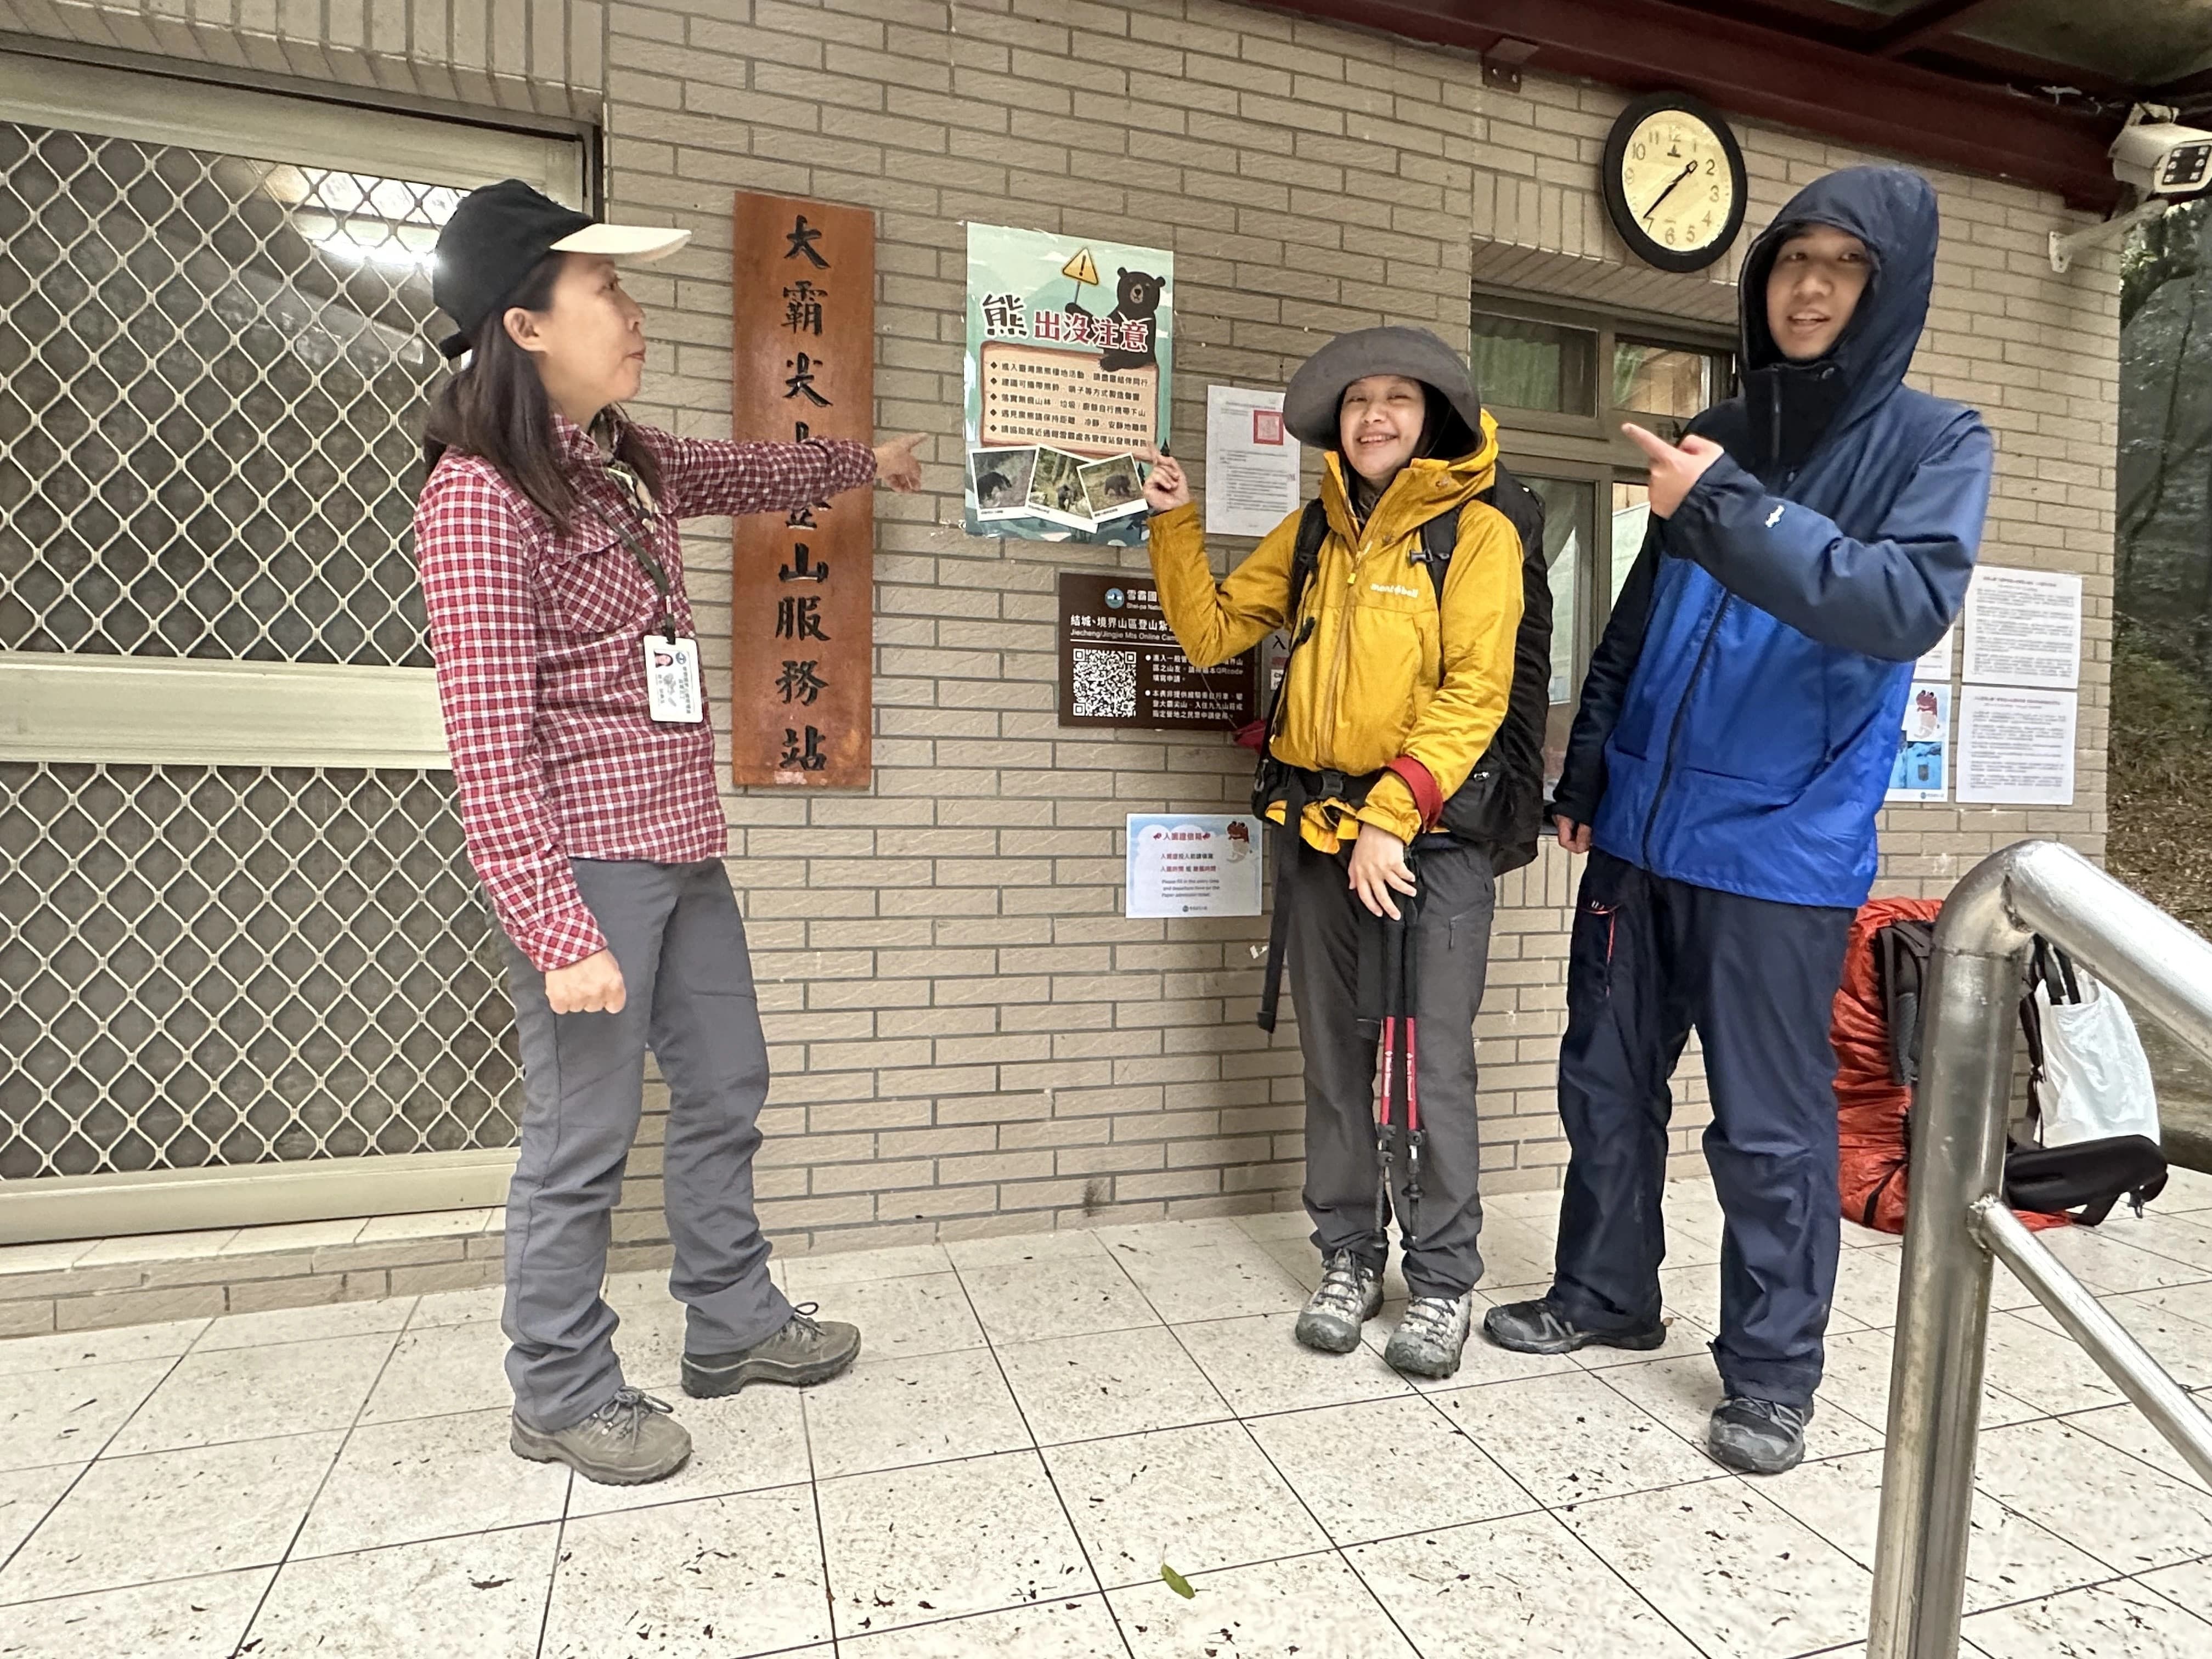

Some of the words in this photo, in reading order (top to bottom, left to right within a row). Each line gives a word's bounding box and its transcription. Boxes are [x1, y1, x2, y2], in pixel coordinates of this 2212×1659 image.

[1649, 131, 1659, 145] 11
[1632, 142, 1646, 160] 10
[1706, 159, 1715, 176] 2
[1709, 185, 1719, 202] 3
[1644, 217, 1654, 234] 7
[1702, 210, 1712, 227] 4
[1664, 227, 1675, 245] 6
[1686, 224, 1695, 242] 5
[982, 294, 1028, 337] 熊
[1034, 311, 1148, 353] 出沒注意
[775, 215, 832, 771] 大霸尖山服務站
[1070, 614, 1173, 631] 結城、境界山區登山紮
